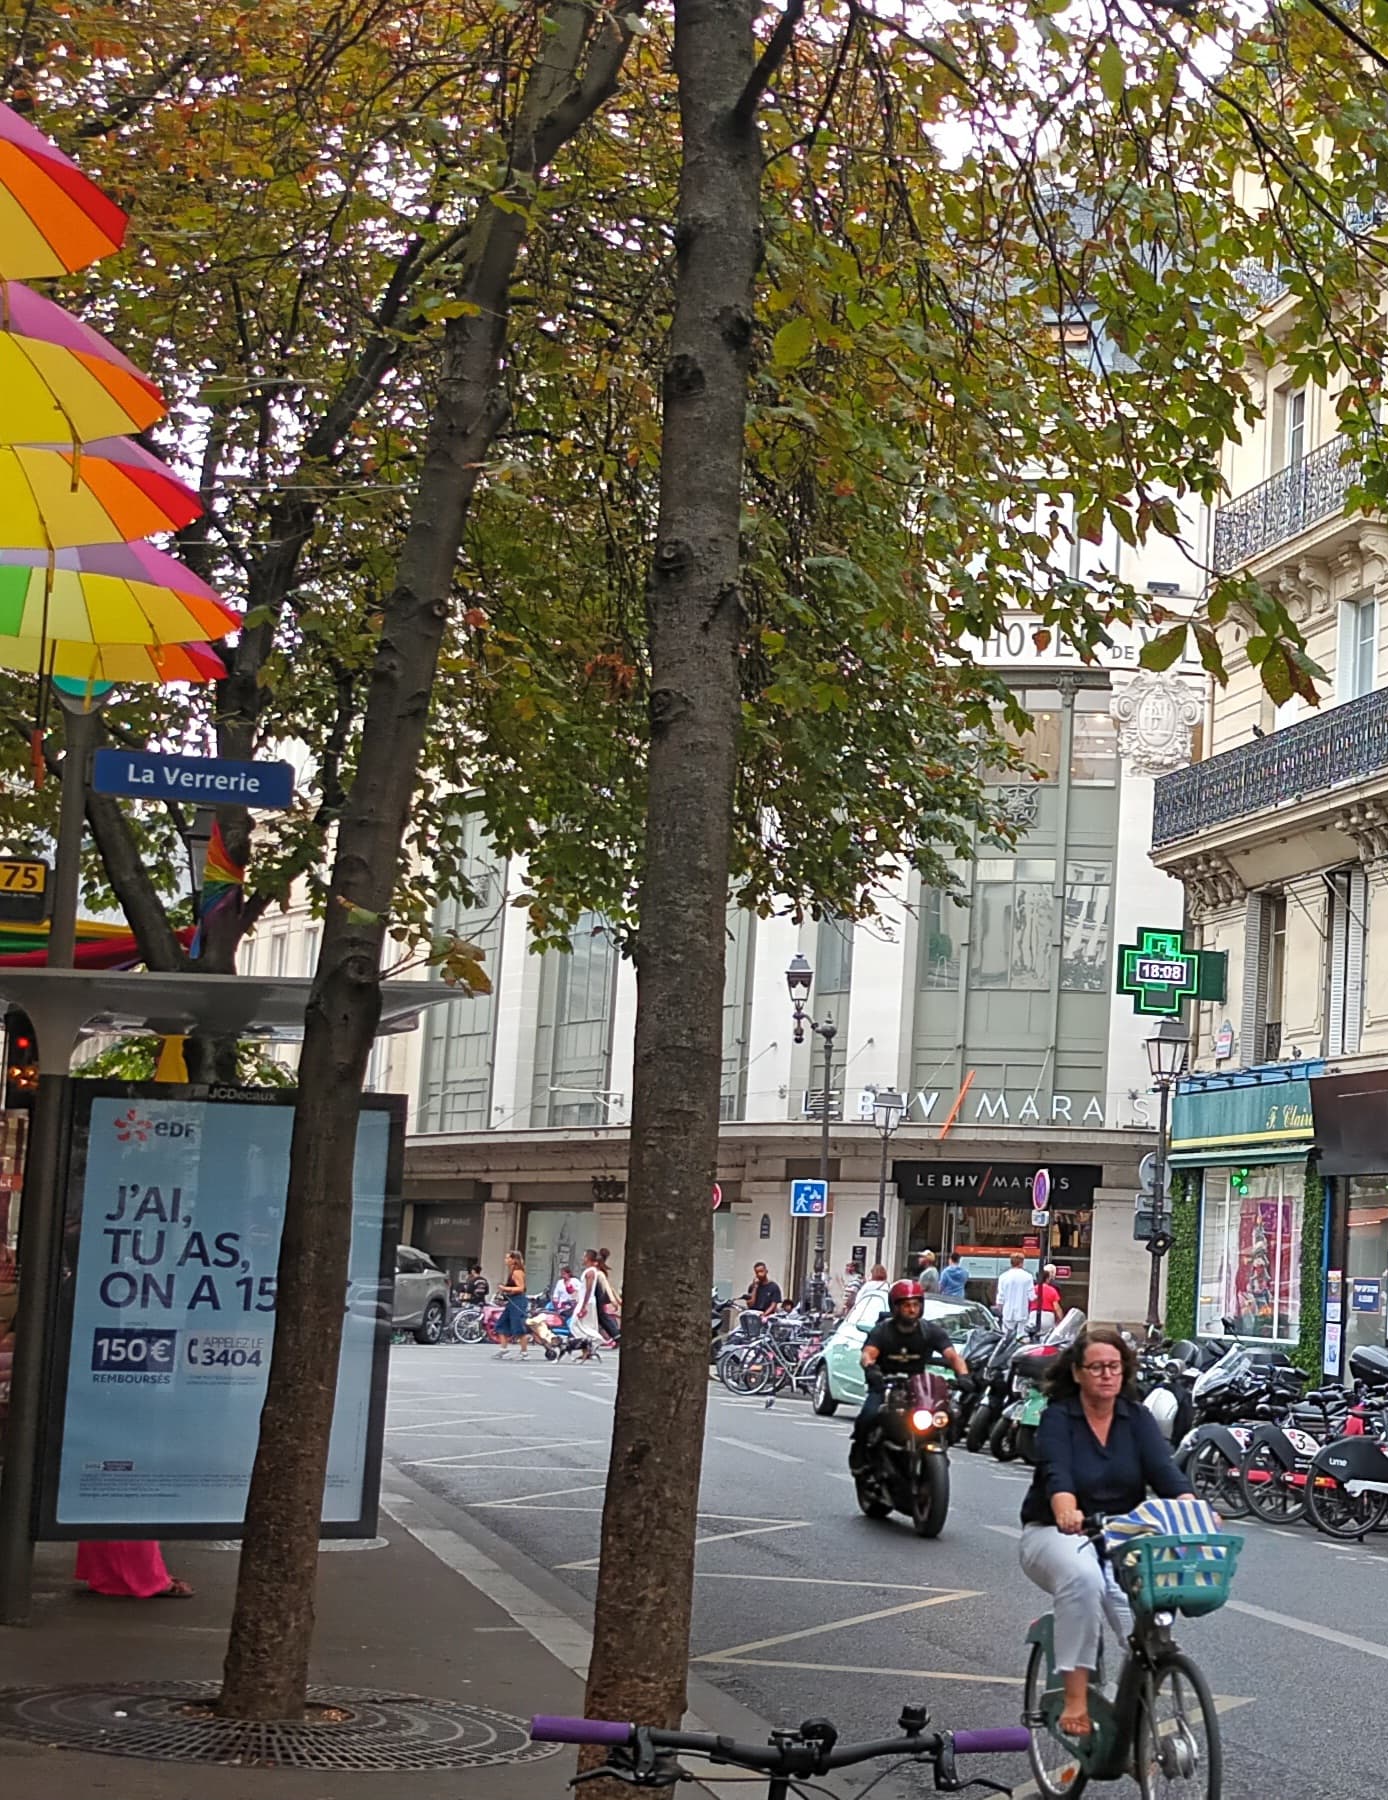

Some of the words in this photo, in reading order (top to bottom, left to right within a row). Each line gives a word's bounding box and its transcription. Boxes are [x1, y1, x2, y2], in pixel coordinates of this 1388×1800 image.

[1112, 645, 1134, 660] DE
[128, 763, 155, 784] La
[163, 766, 260, 793] Verrerie
[3, 865, 38, 889] 75
[1142, 964, 1182, 980] 18:08
[916, 1173, 935, 1187] LE
[105, 1184, 192, 1228] J'AI,
[103, 1228, 166, 1267] TU
[176, 1231, 250, 1273] AS,
[100, 1271, 175, 1310] ON
[187, 1274, 221, 1311] A
[203, 1337, 250, 1349] APPELEZ
[201, 1349, 263, 1367] 3404
[1296, 1433, 1306, 1450] 3
